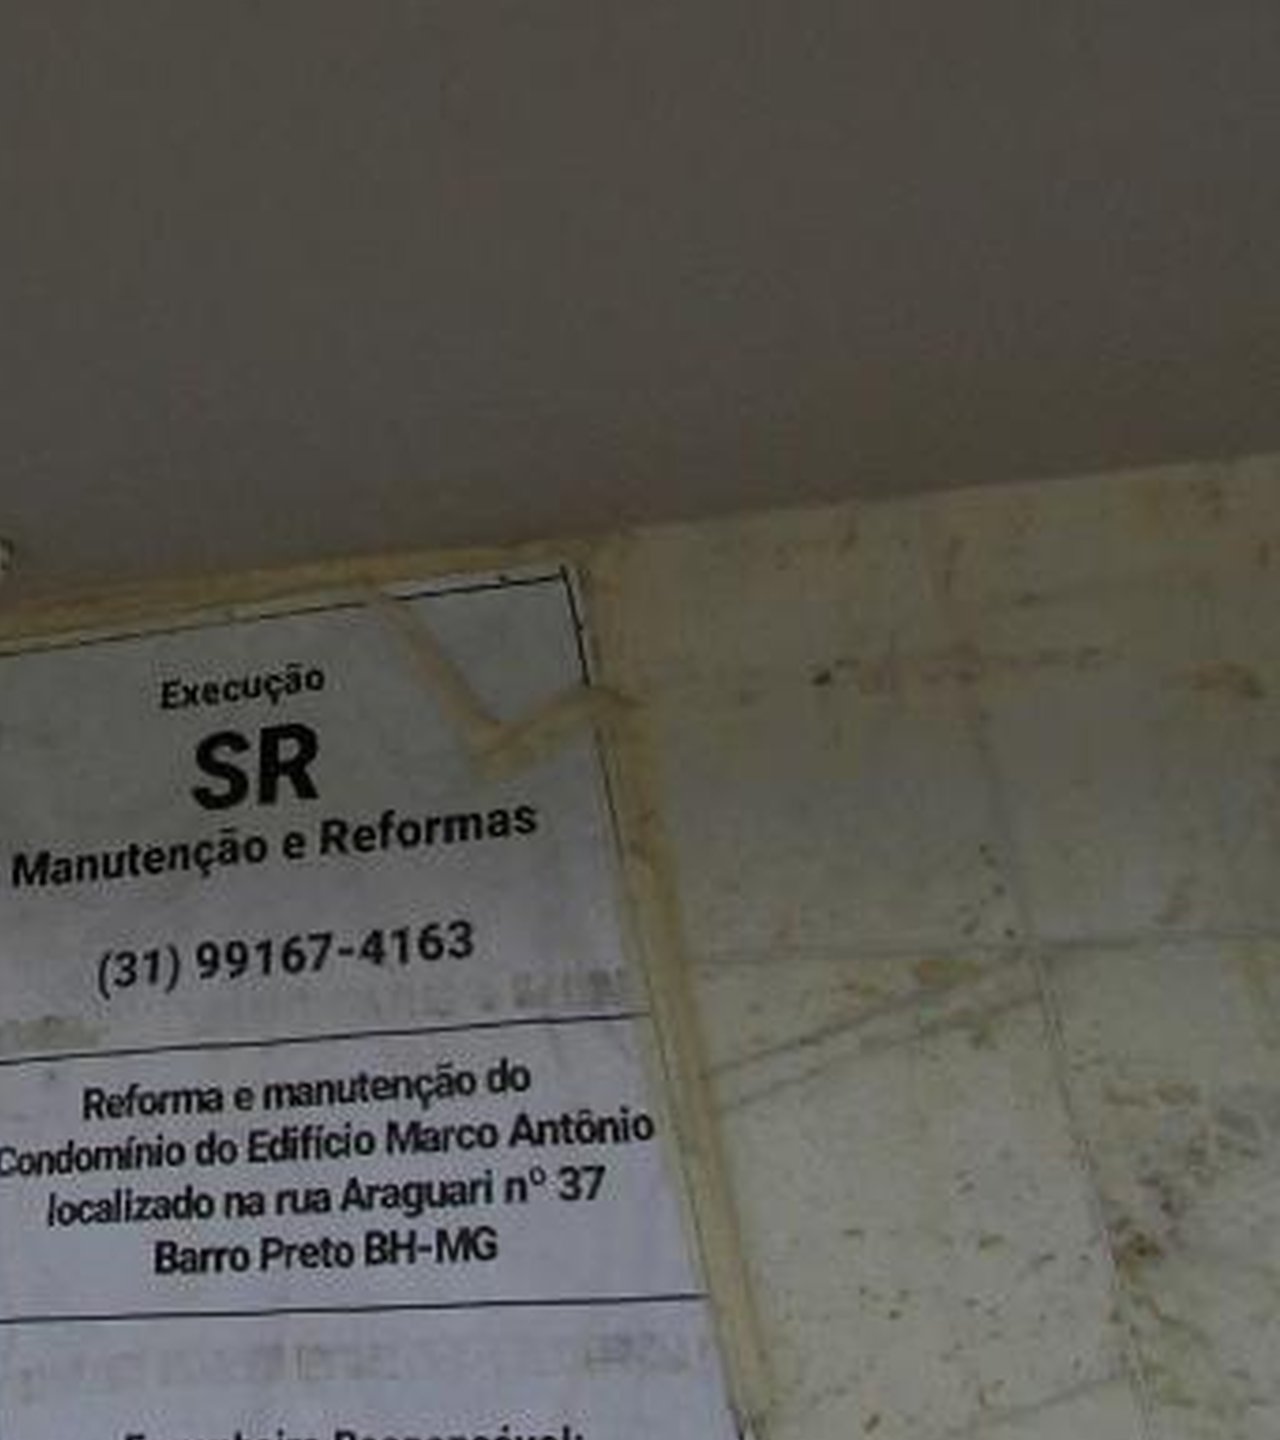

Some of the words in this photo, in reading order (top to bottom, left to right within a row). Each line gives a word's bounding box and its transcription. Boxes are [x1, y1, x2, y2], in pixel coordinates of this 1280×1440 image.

[160, 663, 326, 709] Execução
[191, 723, 319, 811] SR
[11, 828, 268, 888] Manutenção
[282, 832, 306, 859] e
[319, 805, 539, 856] Reformas
[97, 946, 181, 1000] (31)
[197, 921, 475, 979] 99167-4163
[83, 1082, 223, 1120] Reforma
[235, 1088, 254, 1110] e
[262, 1064, 476, 1113] manutenção
[488, 1060, 531, 1093] do
[195, 1129, 237, 1165] do
[247, 1120, 376, 1163] Edifício
[386, 1117, 498, 1154] Marco
[508, 1107, 654, 1148] Antônio
[47, 1185, 214, 1226] localizado
[224, 1192, 265, 1219] na
[276, 1189, 332, 1214] rua
[340, 1170, 494, 1216] Araguari
[557, 1165, 607, 1201] 37
[154, 1240, 250, 1274] Barro
[260, 1235, 355, 1271] Preto
[365, 1226, 498, 1266] BH-MG
